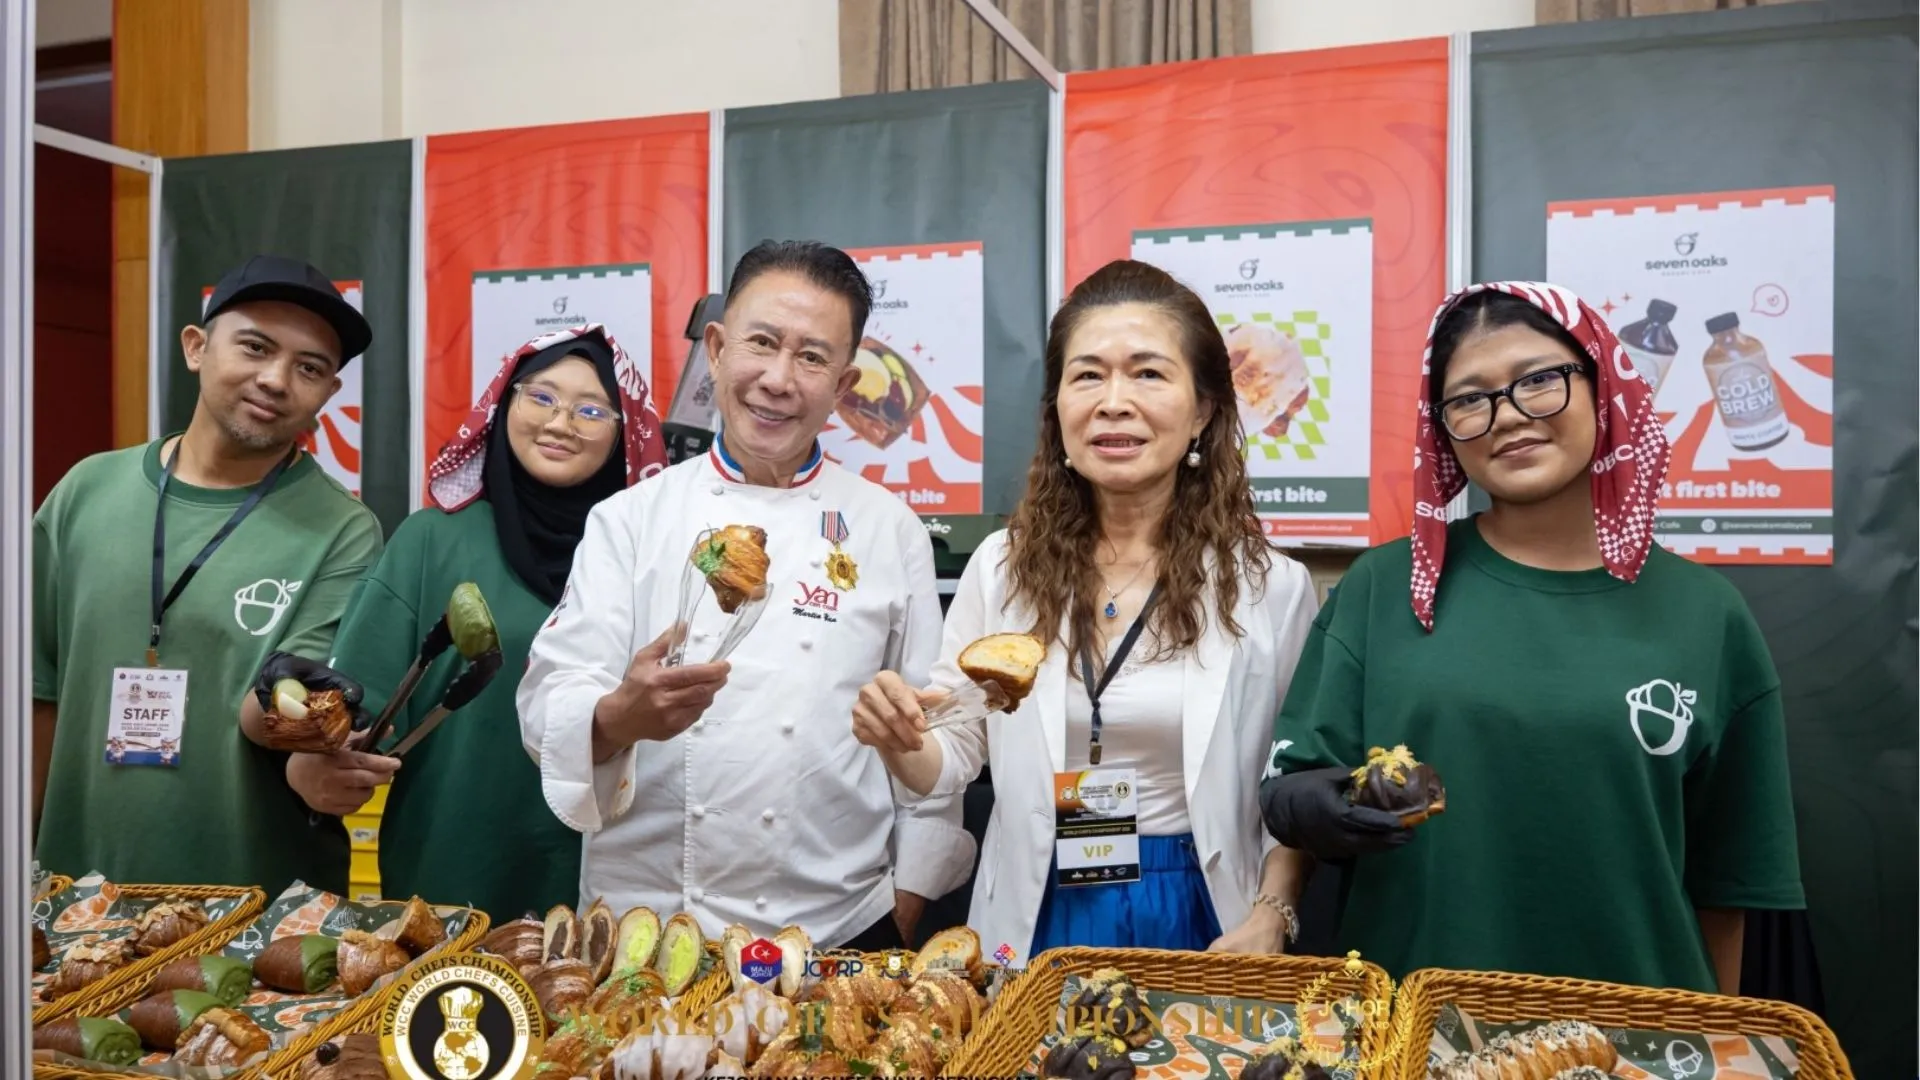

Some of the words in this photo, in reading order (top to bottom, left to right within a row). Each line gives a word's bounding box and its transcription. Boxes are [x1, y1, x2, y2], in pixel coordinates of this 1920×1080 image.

[1645, 259, 1689, 270] seven
[1691, 254, 1728, 268] oaks
[1214, 282, 1252, 293] seven
[1253, 280, 1284, 291] oaks
[1716, 374, 1770, 400] COLD
[1720, 391, 1775, 415] BREW
[1591, 444, 1635, 474] OBC
[910, 488, 947, 504] bite
[1284, 485, 1328, 503] bite
[1675, 480, 1727, 499] first
[1730, 480, 1781, 499] bite
[123, 708, 170, 721] STAFF
[1082, 844, 1113, 859] VIP
